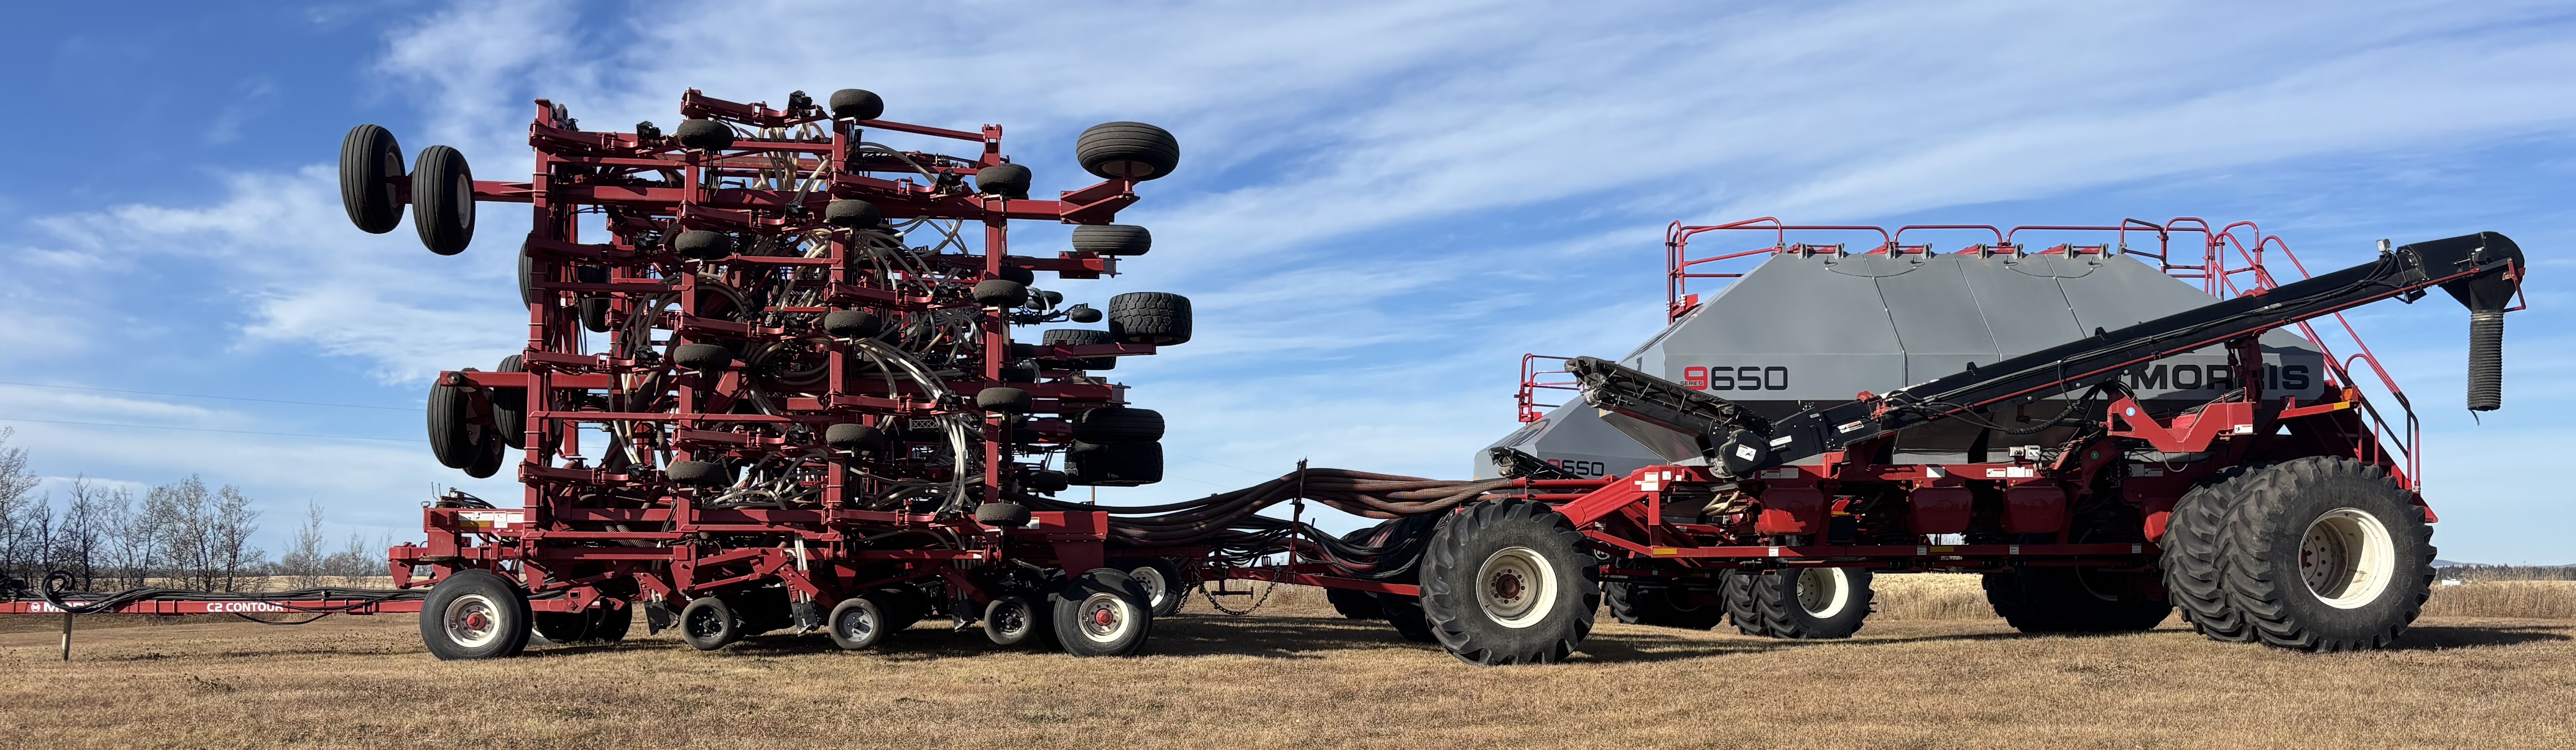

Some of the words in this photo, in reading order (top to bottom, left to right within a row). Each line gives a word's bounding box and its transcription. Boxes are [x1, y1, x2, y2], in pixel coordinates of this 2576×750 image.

[1684, 366, 1788, 391] 9650
[2131, 364, 2310, 390] MORIS
[207, 602, 223, 612] C2
[226, 602, 284, 612] CONTOUR
